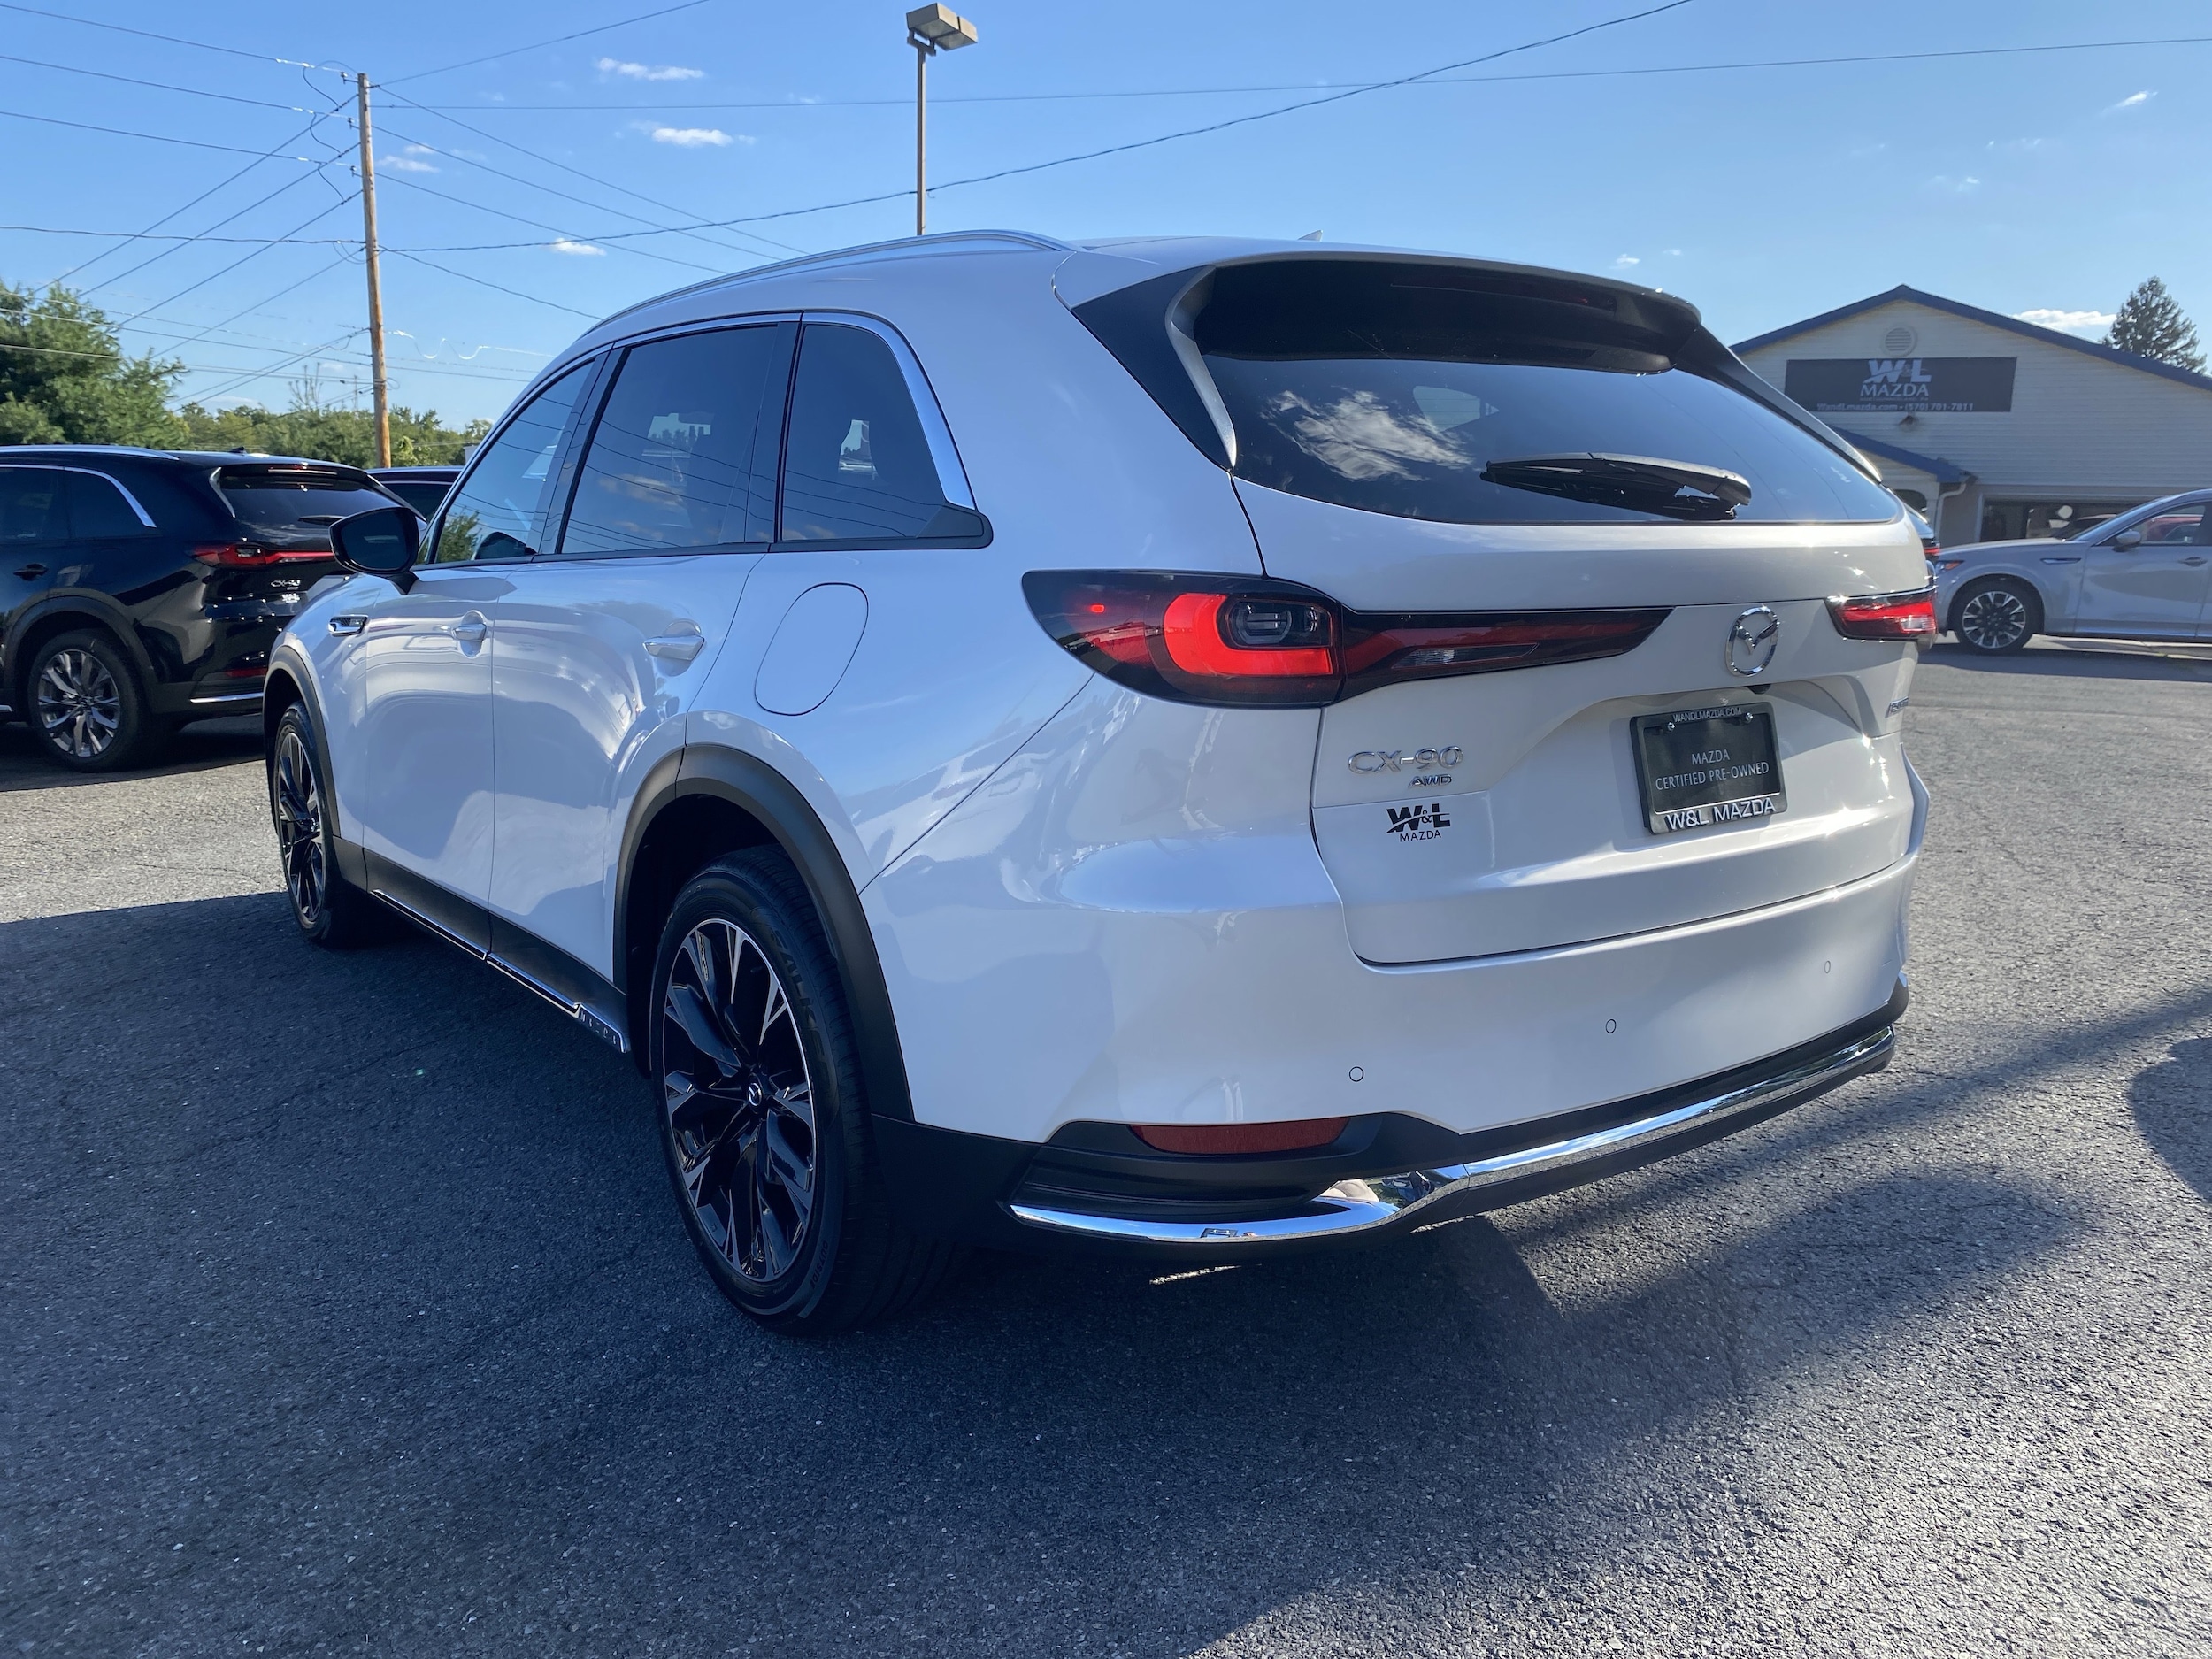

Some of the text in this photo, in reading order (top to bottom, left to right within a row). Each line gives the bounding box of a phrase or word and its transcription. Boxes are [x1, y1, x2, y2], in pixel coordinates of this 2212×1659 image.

[1863, 358, 1932, 383] W&L
[1860, 383, 1930, 397] MAZDA
[1672, 707, 1742, 723] WANDLMAZDA.COM
[1348, 745, 1463, 775] CX-90
[1691, 749, 1731, 765] MAZDA
[1408, 773, 1453, 788] AWD
[1655, 762, 1770, 791] CERTIFIED PRE-OWNED
[1386, 803, 1451, 833] W&L
[1666, 797, 1777, 830] W&L MAZDA
[1399, 830, 1442, 842] MAZDA
